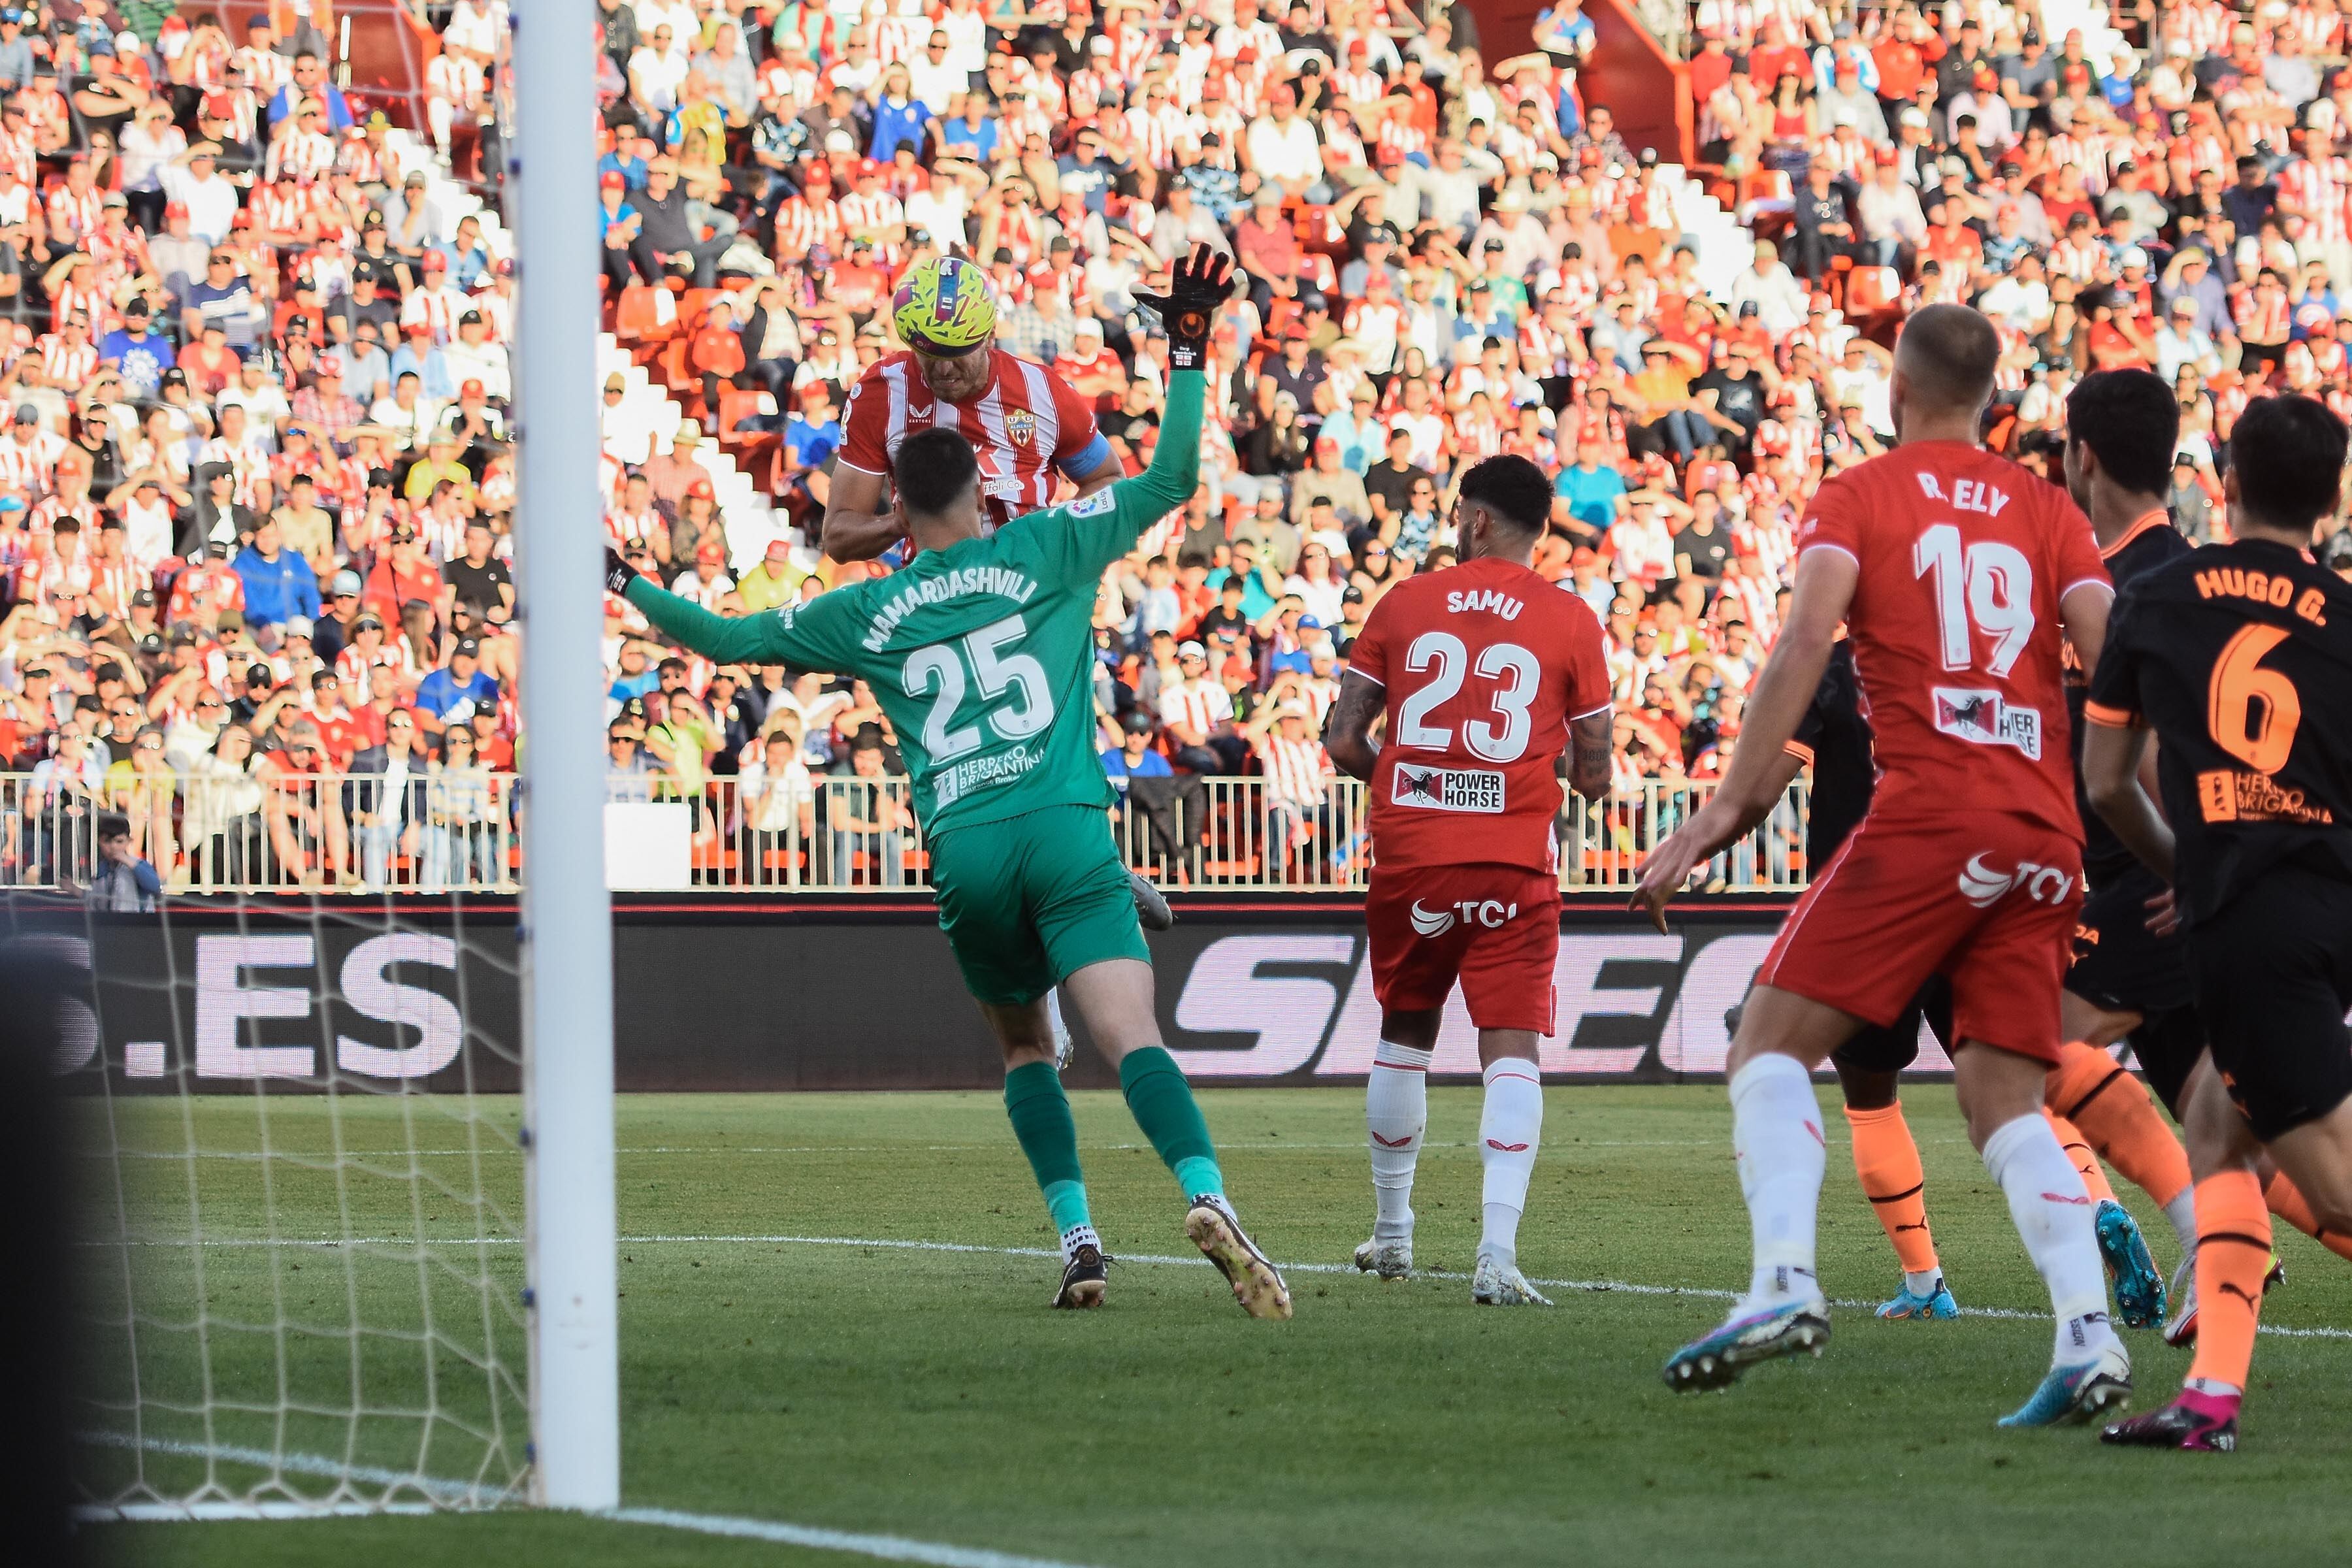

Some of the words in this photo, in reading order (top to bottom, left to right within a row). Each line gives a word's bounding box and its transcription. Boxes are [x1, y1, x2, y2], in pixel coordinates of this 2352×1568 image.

[1916, 472, 1950, 503] R.
[1953, 480, 2010, 517] ELY
[862, 566, 1037, 653] MAMARDASHVILI
[1447, 589, 1524, 621] SAMU
[1911, 523, 2035, 681] 19
[2194, 566, 2294, 608] HUGO
[2295, 588, 2327, 626] G.
[902, 613, 1054, 766] 25
[1396, 631, 1541, 764] 23
[2207, 621, 2301, 775] 6
[1444, 789, 1501, 809] HORSE
[1445, 772, 1501, 792] POWER
